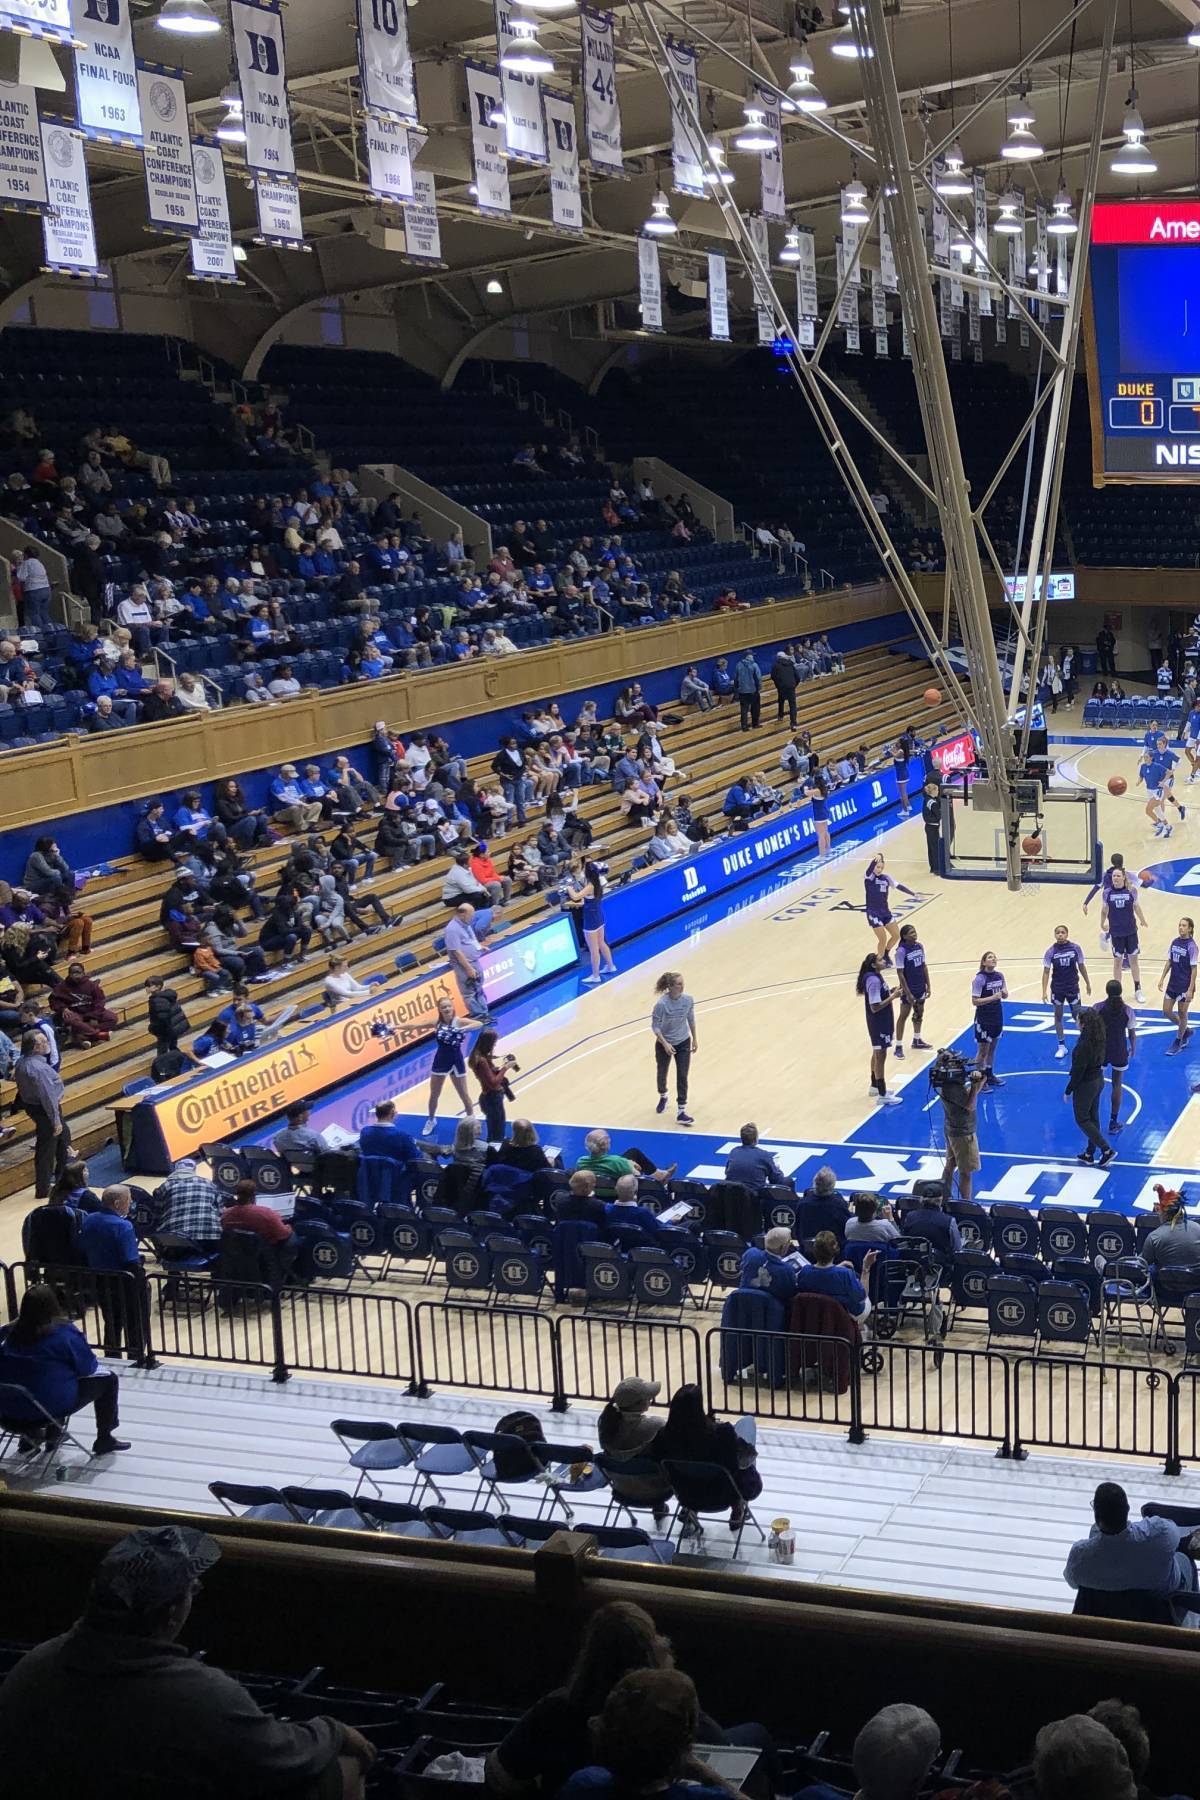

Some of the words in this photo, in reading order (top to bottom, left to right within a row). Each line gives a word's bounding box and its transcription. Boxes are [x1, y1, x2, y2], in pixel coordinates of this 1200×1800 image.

[94, 42, 120, 60] NCAA
[80, 62, 111, 82] FINAL
[112, 69, 136, 87] FOUR
[101, 105, 126, 122] 1963
[150, 131, 183, 147] ATLANTIC
[156, 145, 180, 160] COAST
[146, 158, 192, 175] CONFERENCE
[7, 178, 30, 193] 1954
[150, 172, 192, 189] CHAMPIONS
[261, 188, 298, 205] CHAMPIONS
[165, 204, 185, 217] 1958
[63, 246, 83, 258] 2000
[207, 256, 224, 267] 2001
[1118, 384, 1154, 396] DUKE
[1141, 401, 1154, 425] 0
[722, 847, 753, 876] DUKE
[754, 824, 801, 860] WOMEN'S
[802, 798, 858, 837] BATBALL
[773, 887, 845, 922] COACH
[342, 984, 441, 1055] Continental
[176, 1050, 300, 1134] Continental
[222, 1090, 288, 1130] TIRE
